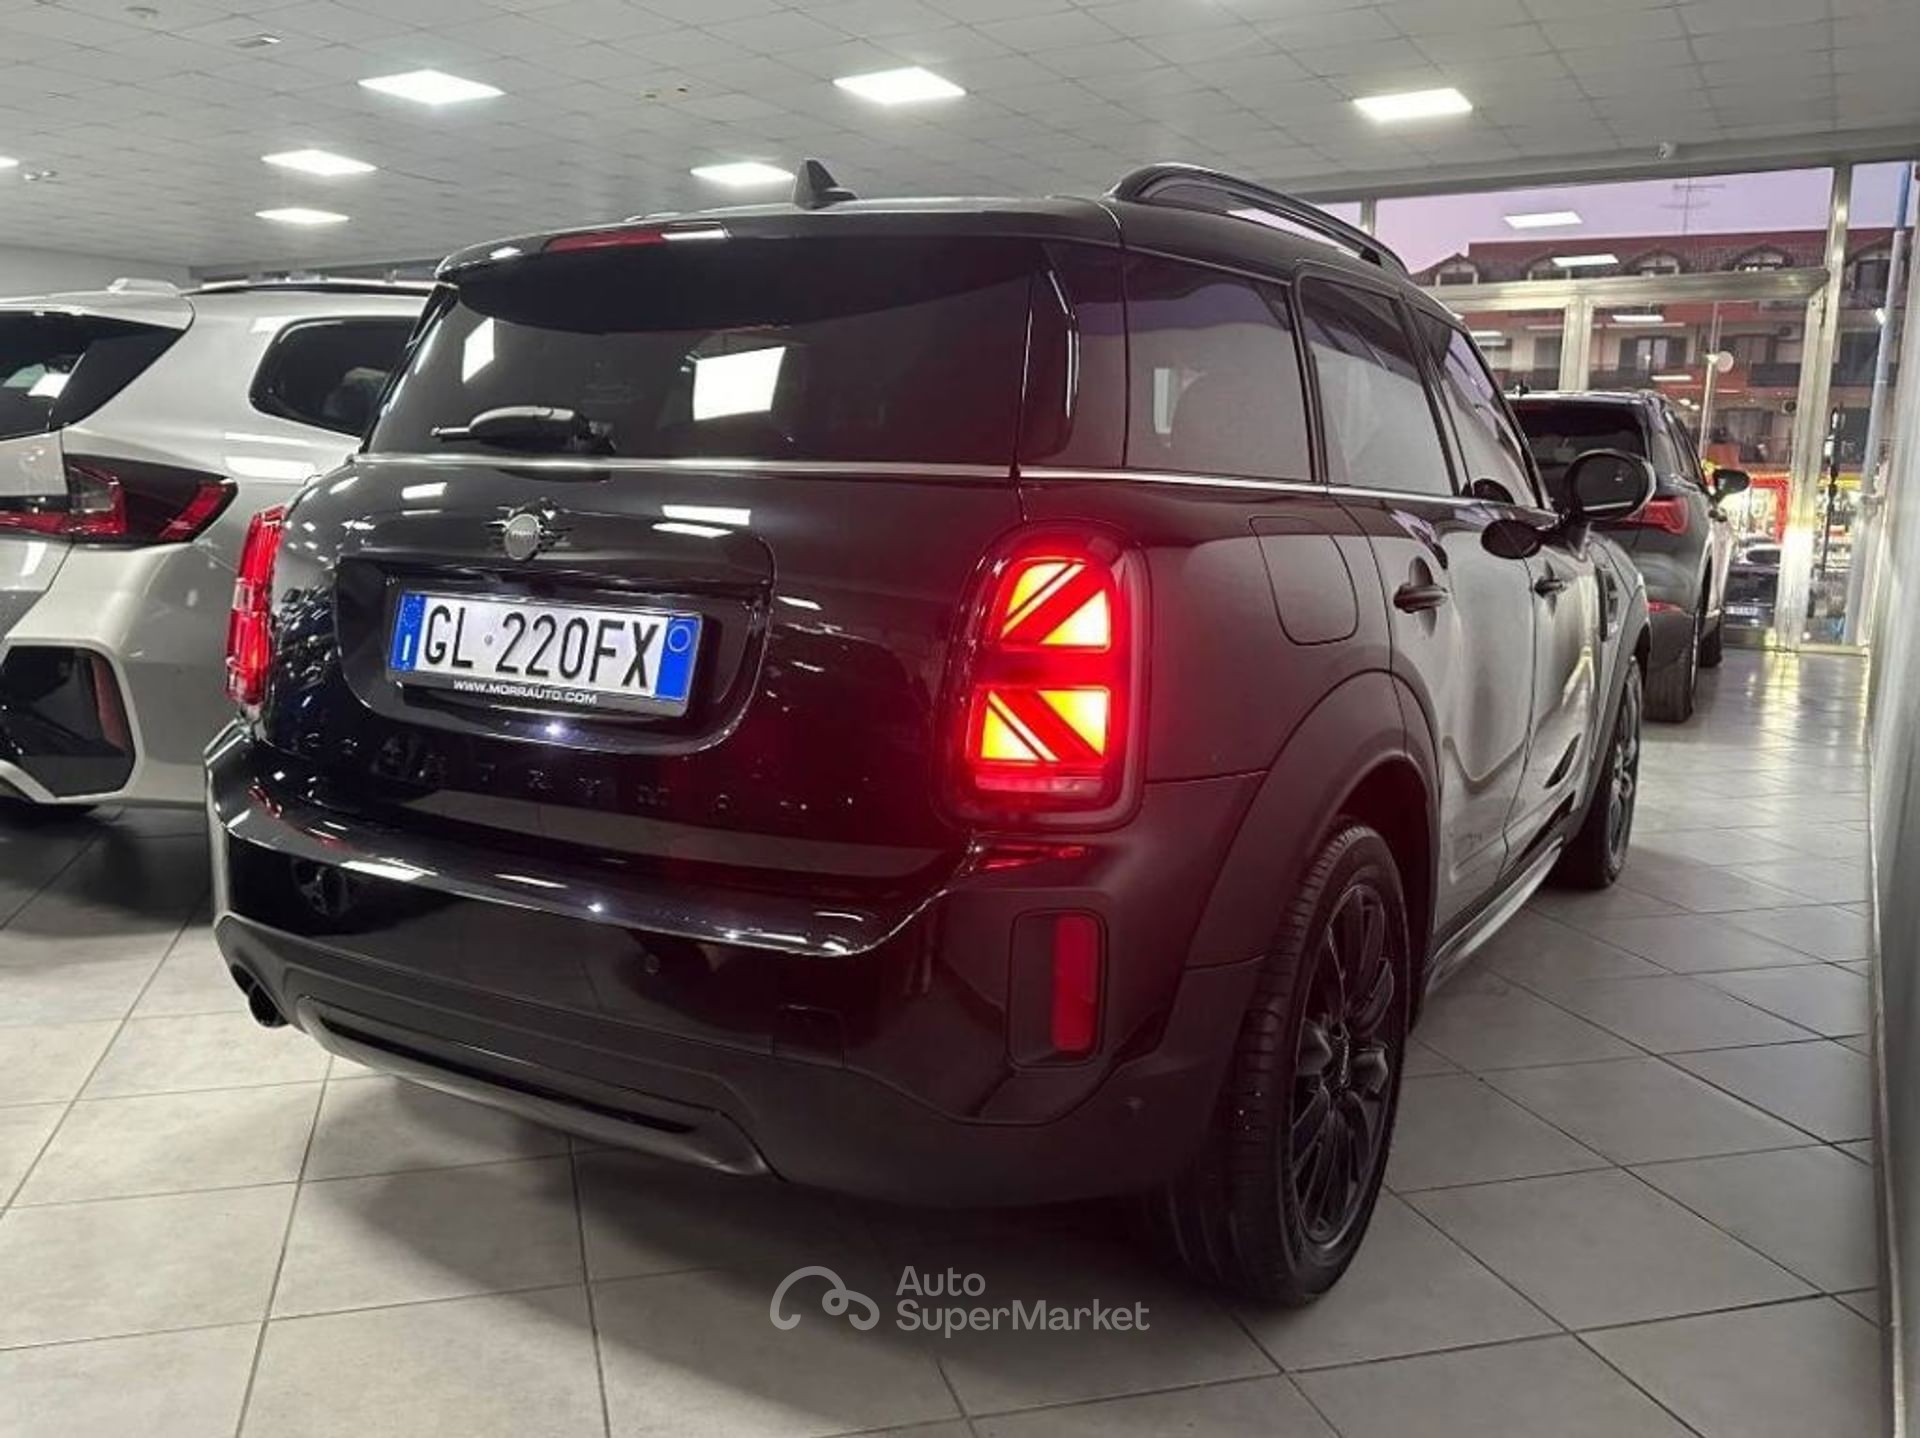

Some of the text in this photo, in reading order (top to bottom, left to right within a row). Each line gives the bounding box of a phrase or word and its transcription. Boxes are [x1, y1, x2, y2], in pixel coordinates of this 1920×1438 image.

[424, 605, 473, 668] GL
[495, 612, 659, 688] 220FX
[453, 680, 598, 705] WWW.MORRAUTO.COM
